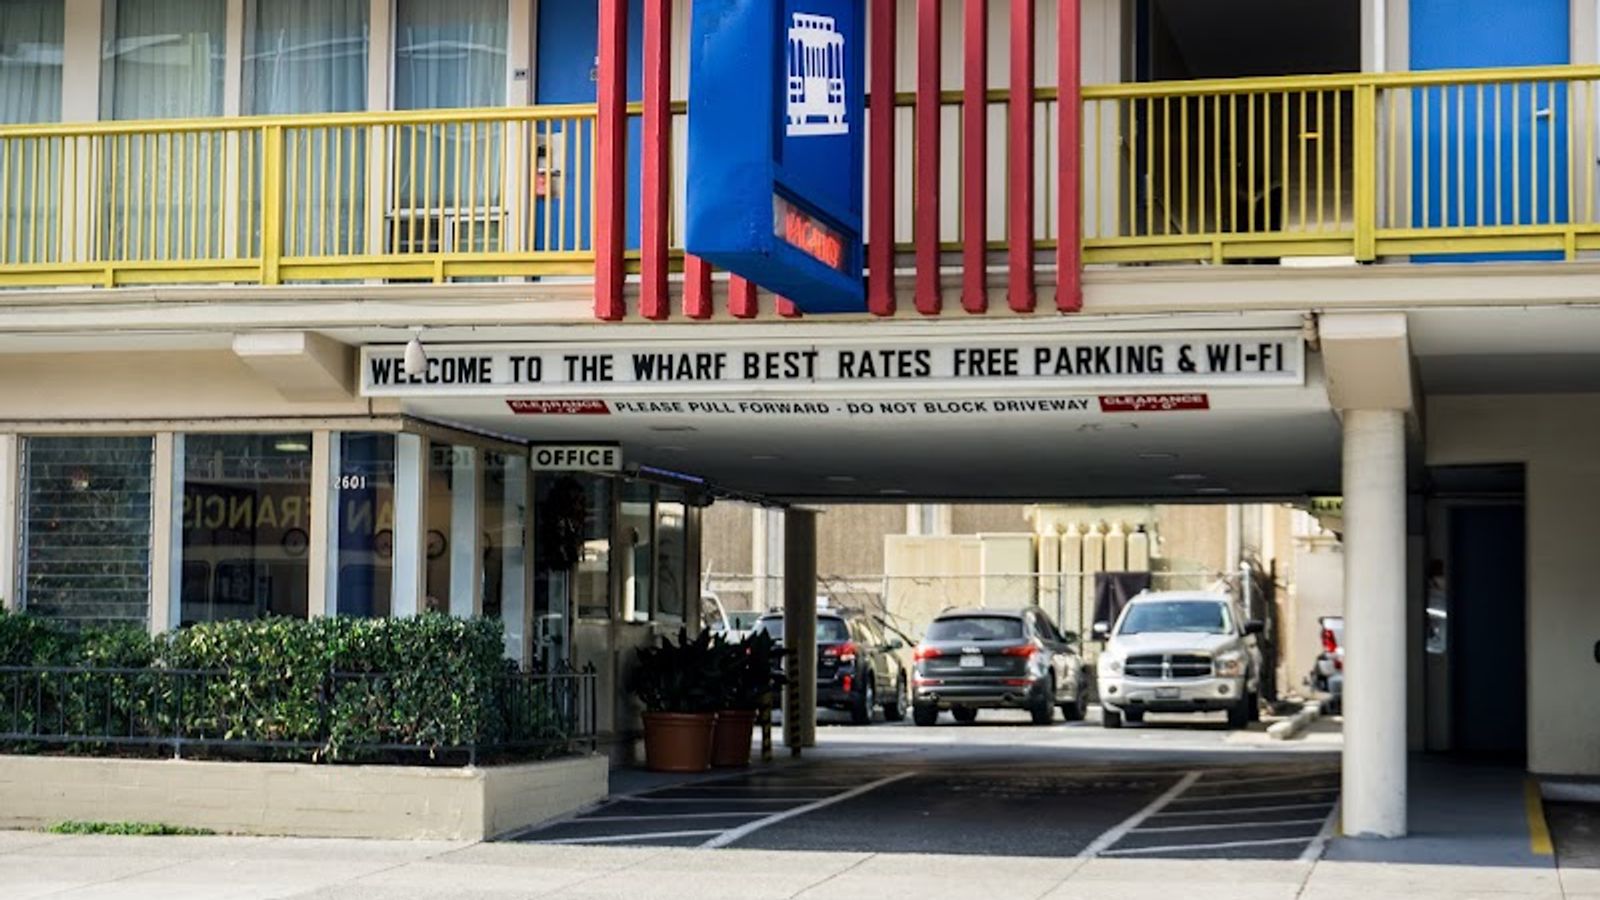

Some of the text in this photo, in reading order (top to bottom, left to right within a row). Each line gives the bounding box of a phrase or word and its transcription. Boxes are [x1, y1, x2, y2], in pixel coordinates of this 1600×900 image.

[510, 355, 542, 383] TO
[564, 354, 613, 382] THE
[632, 352, 727, 381] WHARF
[744, 351, 819, 380] BEST
[839, 350, 931, 378] RATES
[954, 348, 1019, 377] FREE
[1035, 345, 1164, 375] PARKING
[1178, 345, 1197, 373] &
[1207, 343, 1284, 372] WI-FI
[615, 402, 683, 412] PLEASE
[688, 402, 735, 413] PULL
[739, 402, 830, 413] FORWARD
[847, 403, 874, 413] DO
[880, 402, 916, 413] NOT
[924, 401, 987, 413] BLOCK
[993, 400, 1089, 411] DRIVEWAY
[1104, 395, 1204, 404] CLEARANCE
[537, 449, 614, 466] OFFICE
[334, 475, 366, 489] 2601
